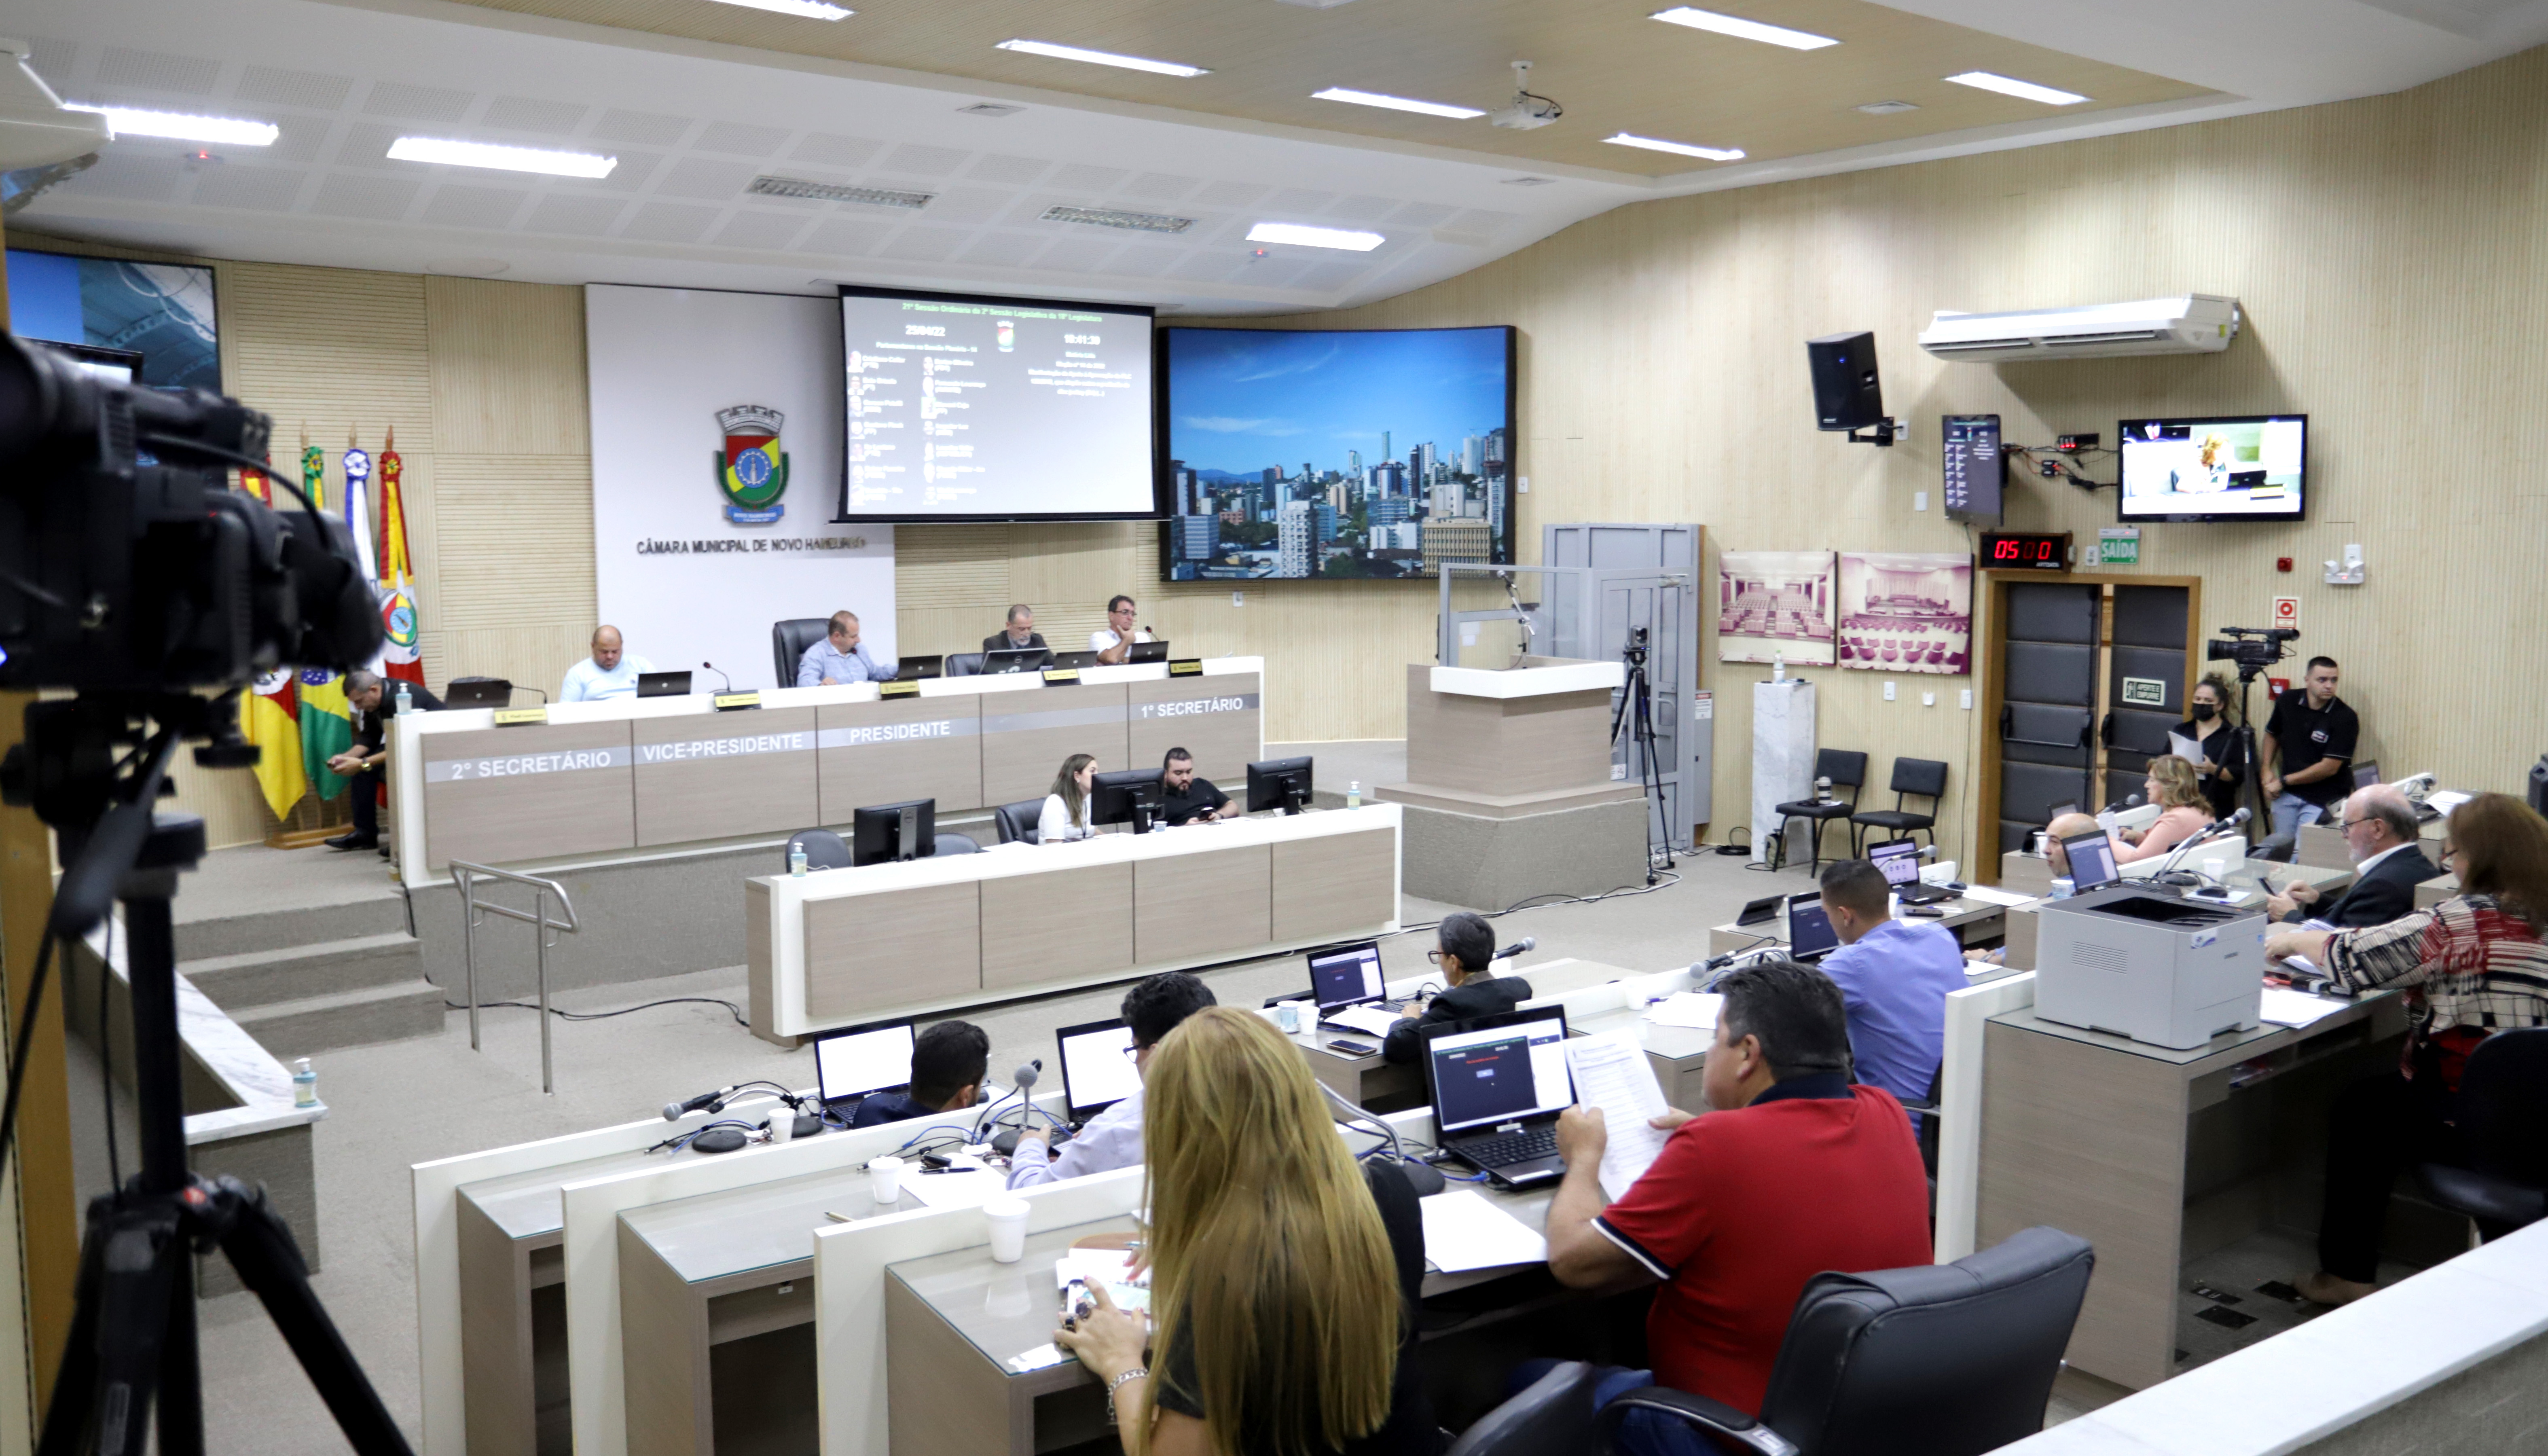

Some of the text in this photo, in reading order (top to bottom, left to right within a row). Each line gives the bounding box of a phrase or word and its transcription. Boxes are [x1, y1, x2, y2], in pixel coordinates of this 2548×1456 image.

[637, 538, 689, 554] CÂMARA
[692, 540, 750, 553] MUNICIPAL
[753, 539, 767, 552] DE
[771, 538, 802, 551] NOVO
[1994, 541, 2019, 559] 05
[2101, 539, 2137, 558] SAÍDA
[1158, 697, 1243, 717] SECRETÁRIO
[851, 721, 950, 743] PRESIDENTE
[643, 734, 802, 761] VICE-PRESIDENTE
[478, 750, 611, 777] SECRETÁRIO
